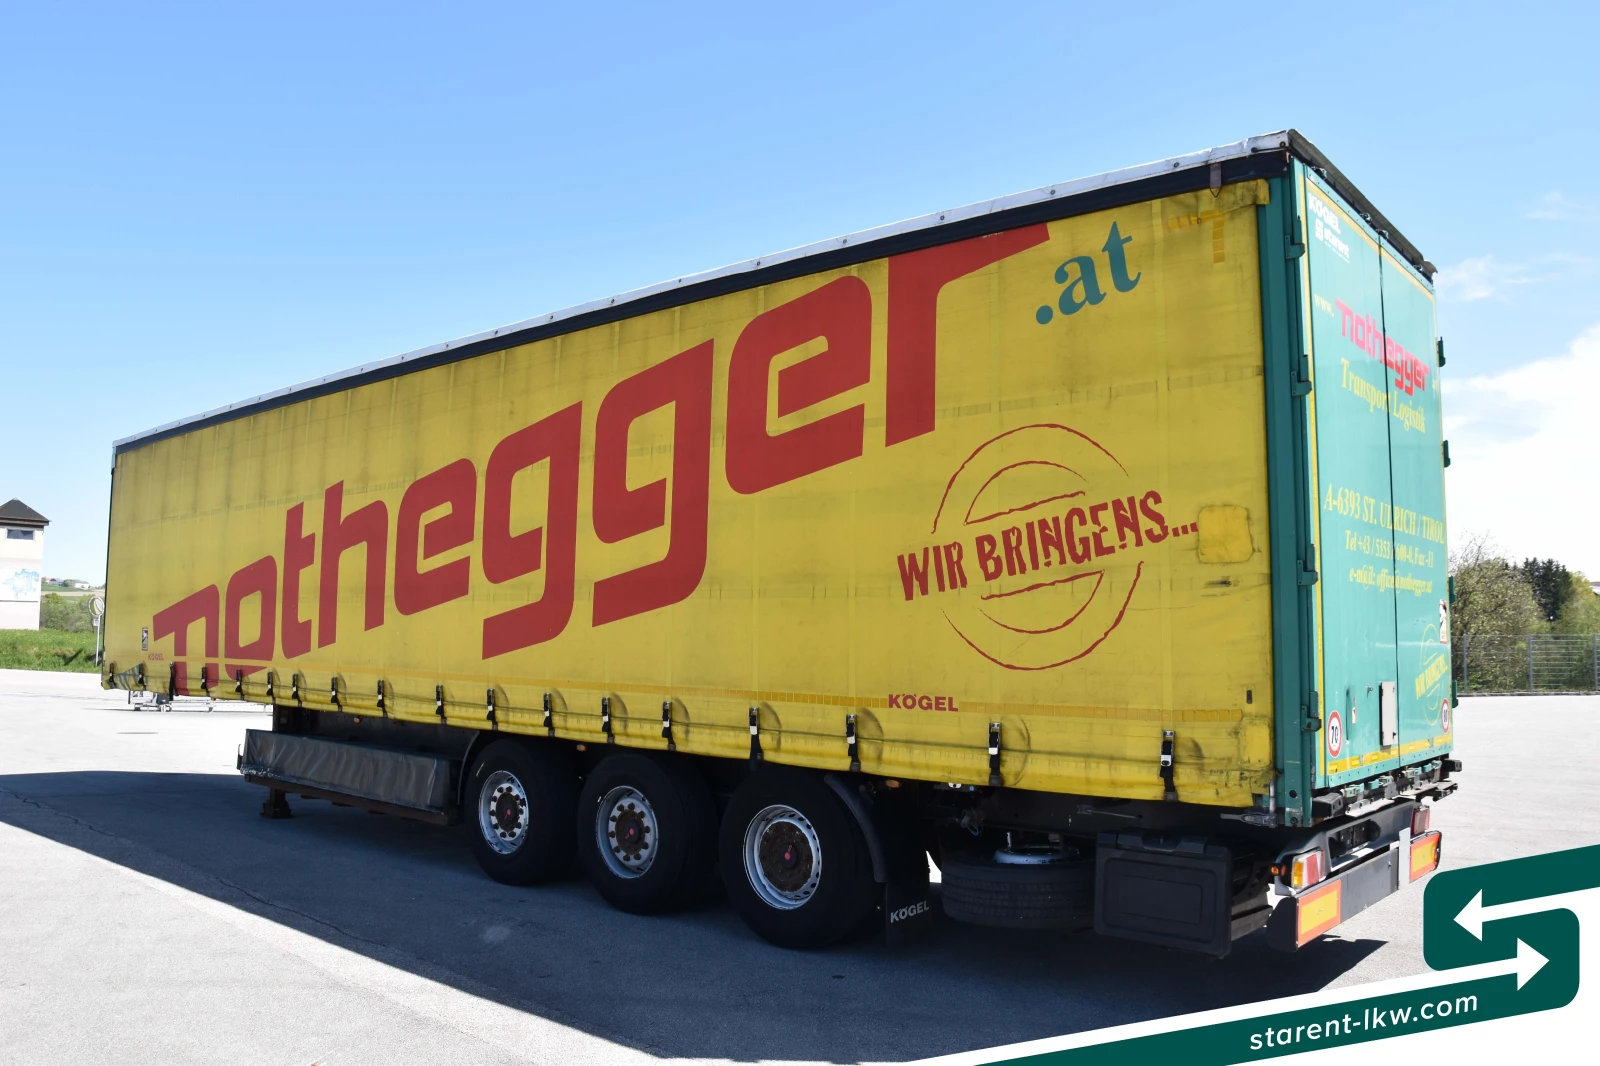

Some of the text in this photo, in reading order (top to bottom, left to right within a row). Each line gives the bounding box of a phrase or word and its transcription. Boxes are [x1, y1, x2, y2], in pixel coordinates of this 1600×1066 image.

[1314, 293, 1431, 397] www. nothegger
[1340, 357, 1392, 414] Transport
[1393, 390, 1426, 434] Logistik
[152, 221, 1142, 697] nothegger .at
[1323, 483, 1361, 519] A-6393
[1362, 495, 1378, 525] ST.
[1379, 501, 1417, 536] ULRICH
[1422, 515, 1445, 544] TIROL
[1345, 529, 1357, 551] Tel
[1358, 535, 1371, 555] +43
[896, 490, 1200, 602] WIR BRINGENS...
[888, 693, 959, 712] KÖGEL
[1331, 725, 1340, 744] 70
[890, 900, 930, 923] KÖGEL
